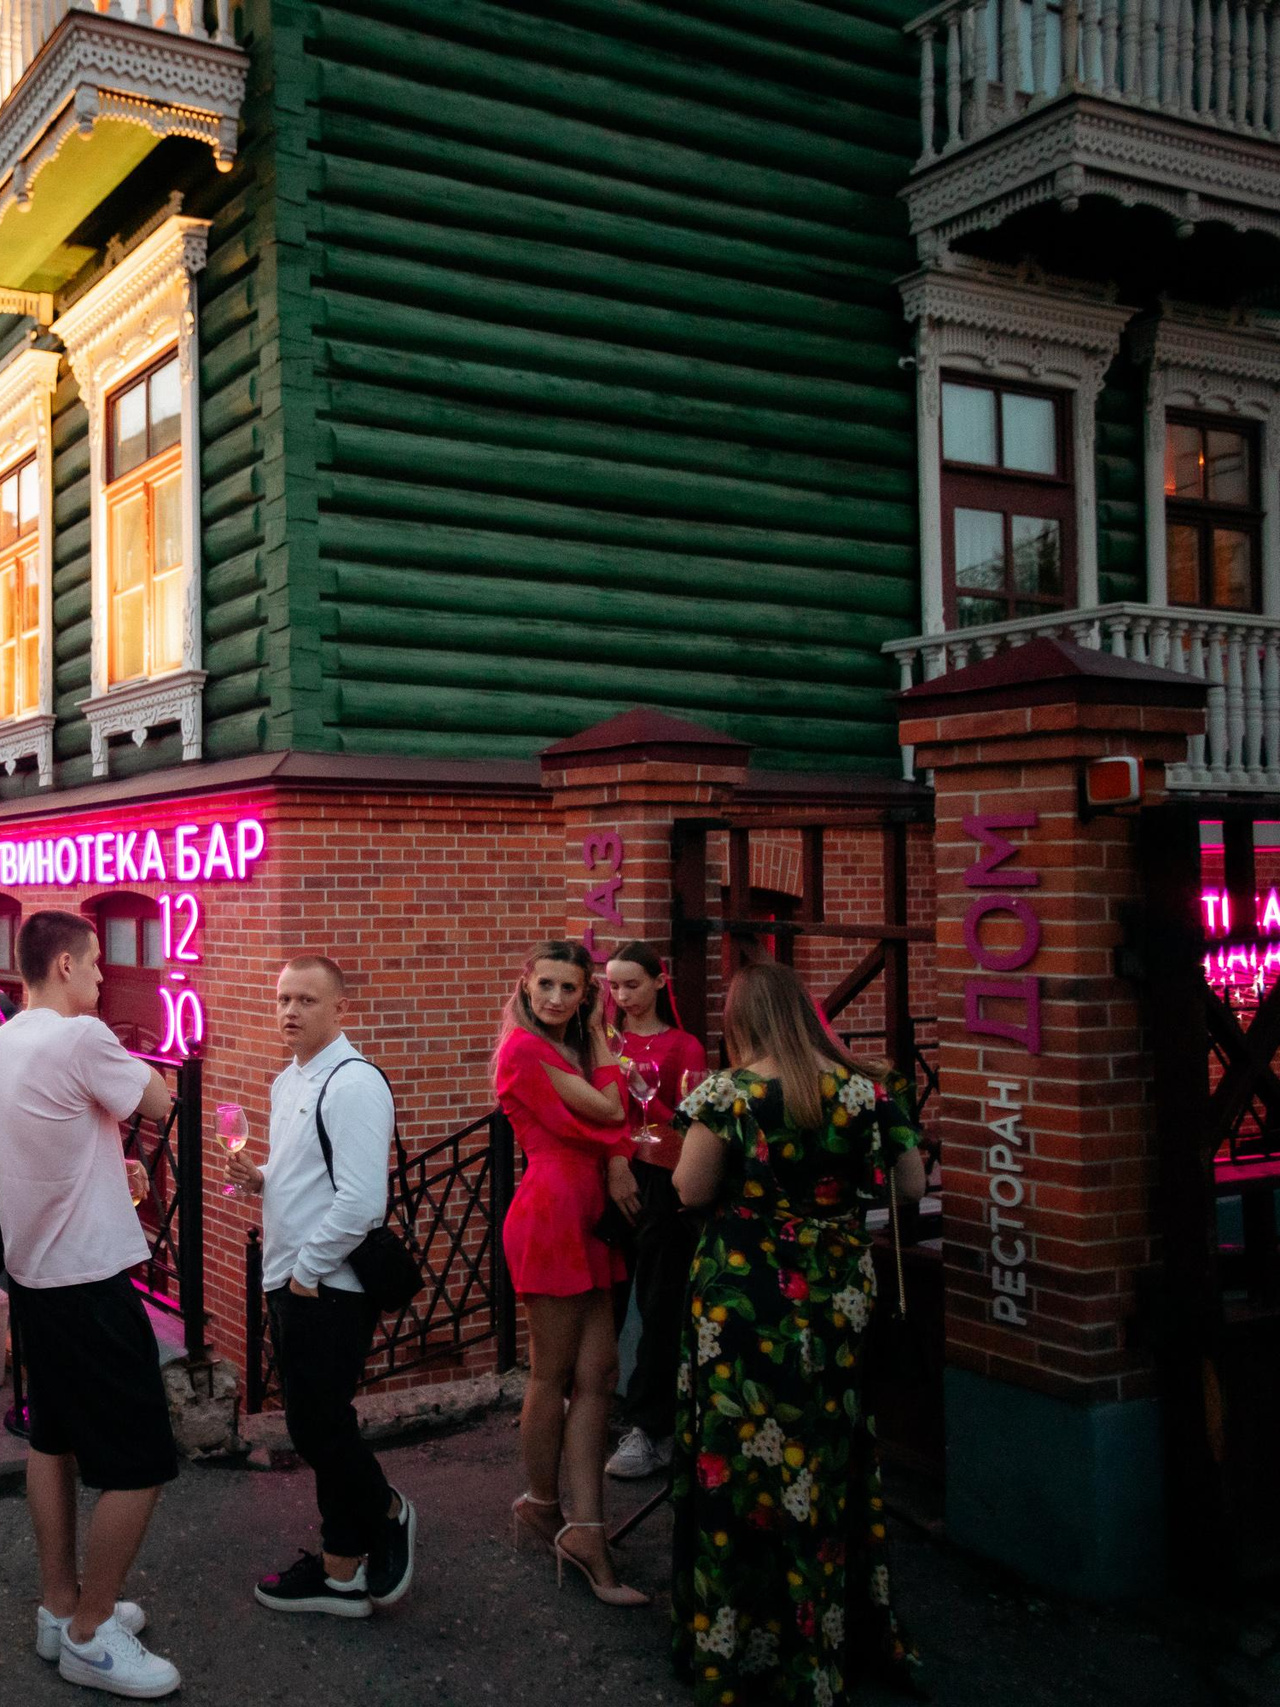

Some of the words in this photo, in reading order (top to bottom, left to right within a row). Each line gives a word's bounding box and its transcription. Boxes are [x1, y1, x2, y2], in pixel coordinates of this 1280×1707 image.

[0, 829, 167, 885] ВИНОТЕКА
[174, 818, 265, 882] БАР
[158, 892, 200, 962] 12
[963, 810, 1041, 1055] ДОМ
[987, 1080, 1028, 1326] РЕСТОРАН
